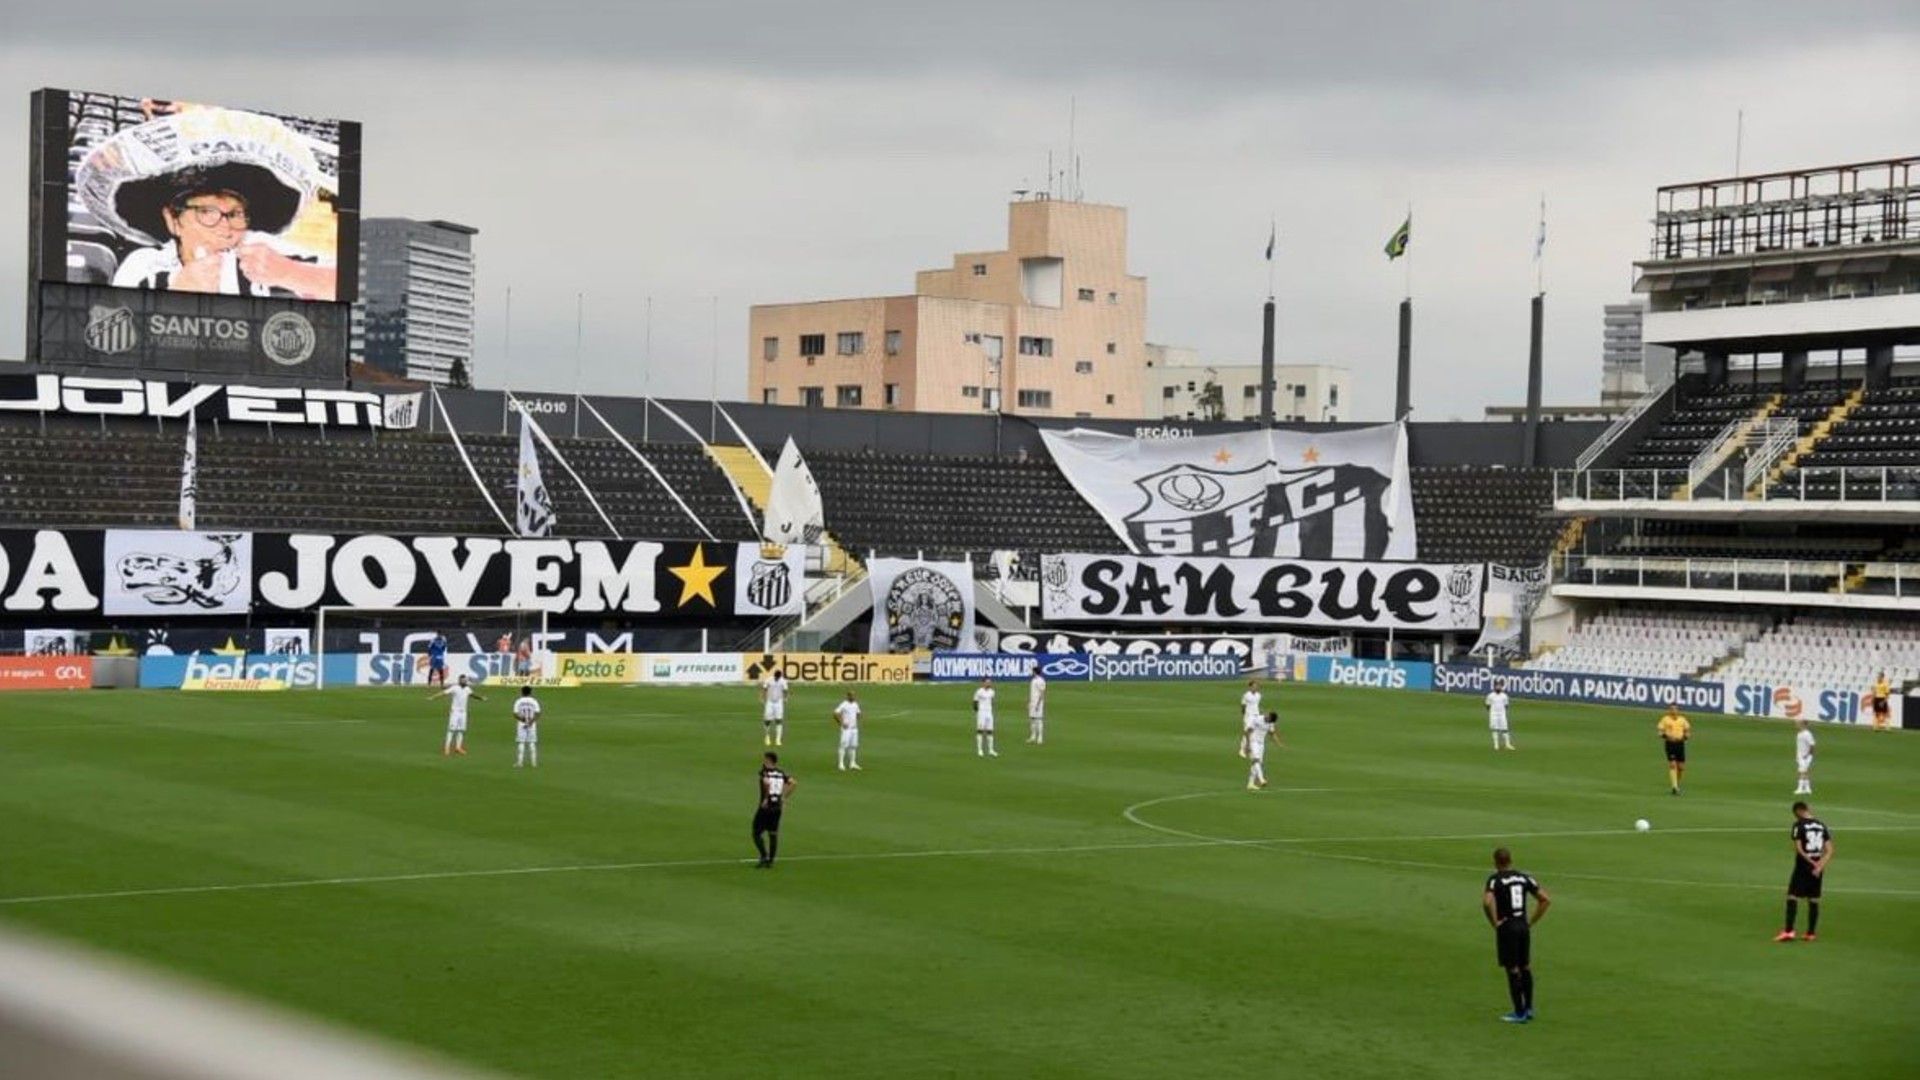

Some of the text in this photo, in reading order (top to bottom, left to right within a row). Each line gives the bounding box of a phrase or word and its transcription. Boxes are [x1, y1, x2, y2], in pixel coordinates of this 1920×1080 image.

[150, 315, 249, 339] SANTOS
[0, 530, 99, 610] A
[259, 534, 664, 613] JOVEM
[1081, 559, 1440, 623] SANGUE
[55, 666, 86, 681] GOL
[185, 650, 317, 687] betcris
[369, 654, 414, 684] Sil
[469, 654, 510, 684] Sil
[562, 658, 625, 678] Posto é
[675, 664, 737, 673] PETROBRAS
[1095, 655, 1235, 680] SportPromotion
[1330, 658, 1406, 688] betcris
[1434, 666, 1721, 707] SportPromotion A PAIXÃO VOLTOU
[1734, 684, 1771, 716] Sil
[1818, 690, 1858, 723] Sil
